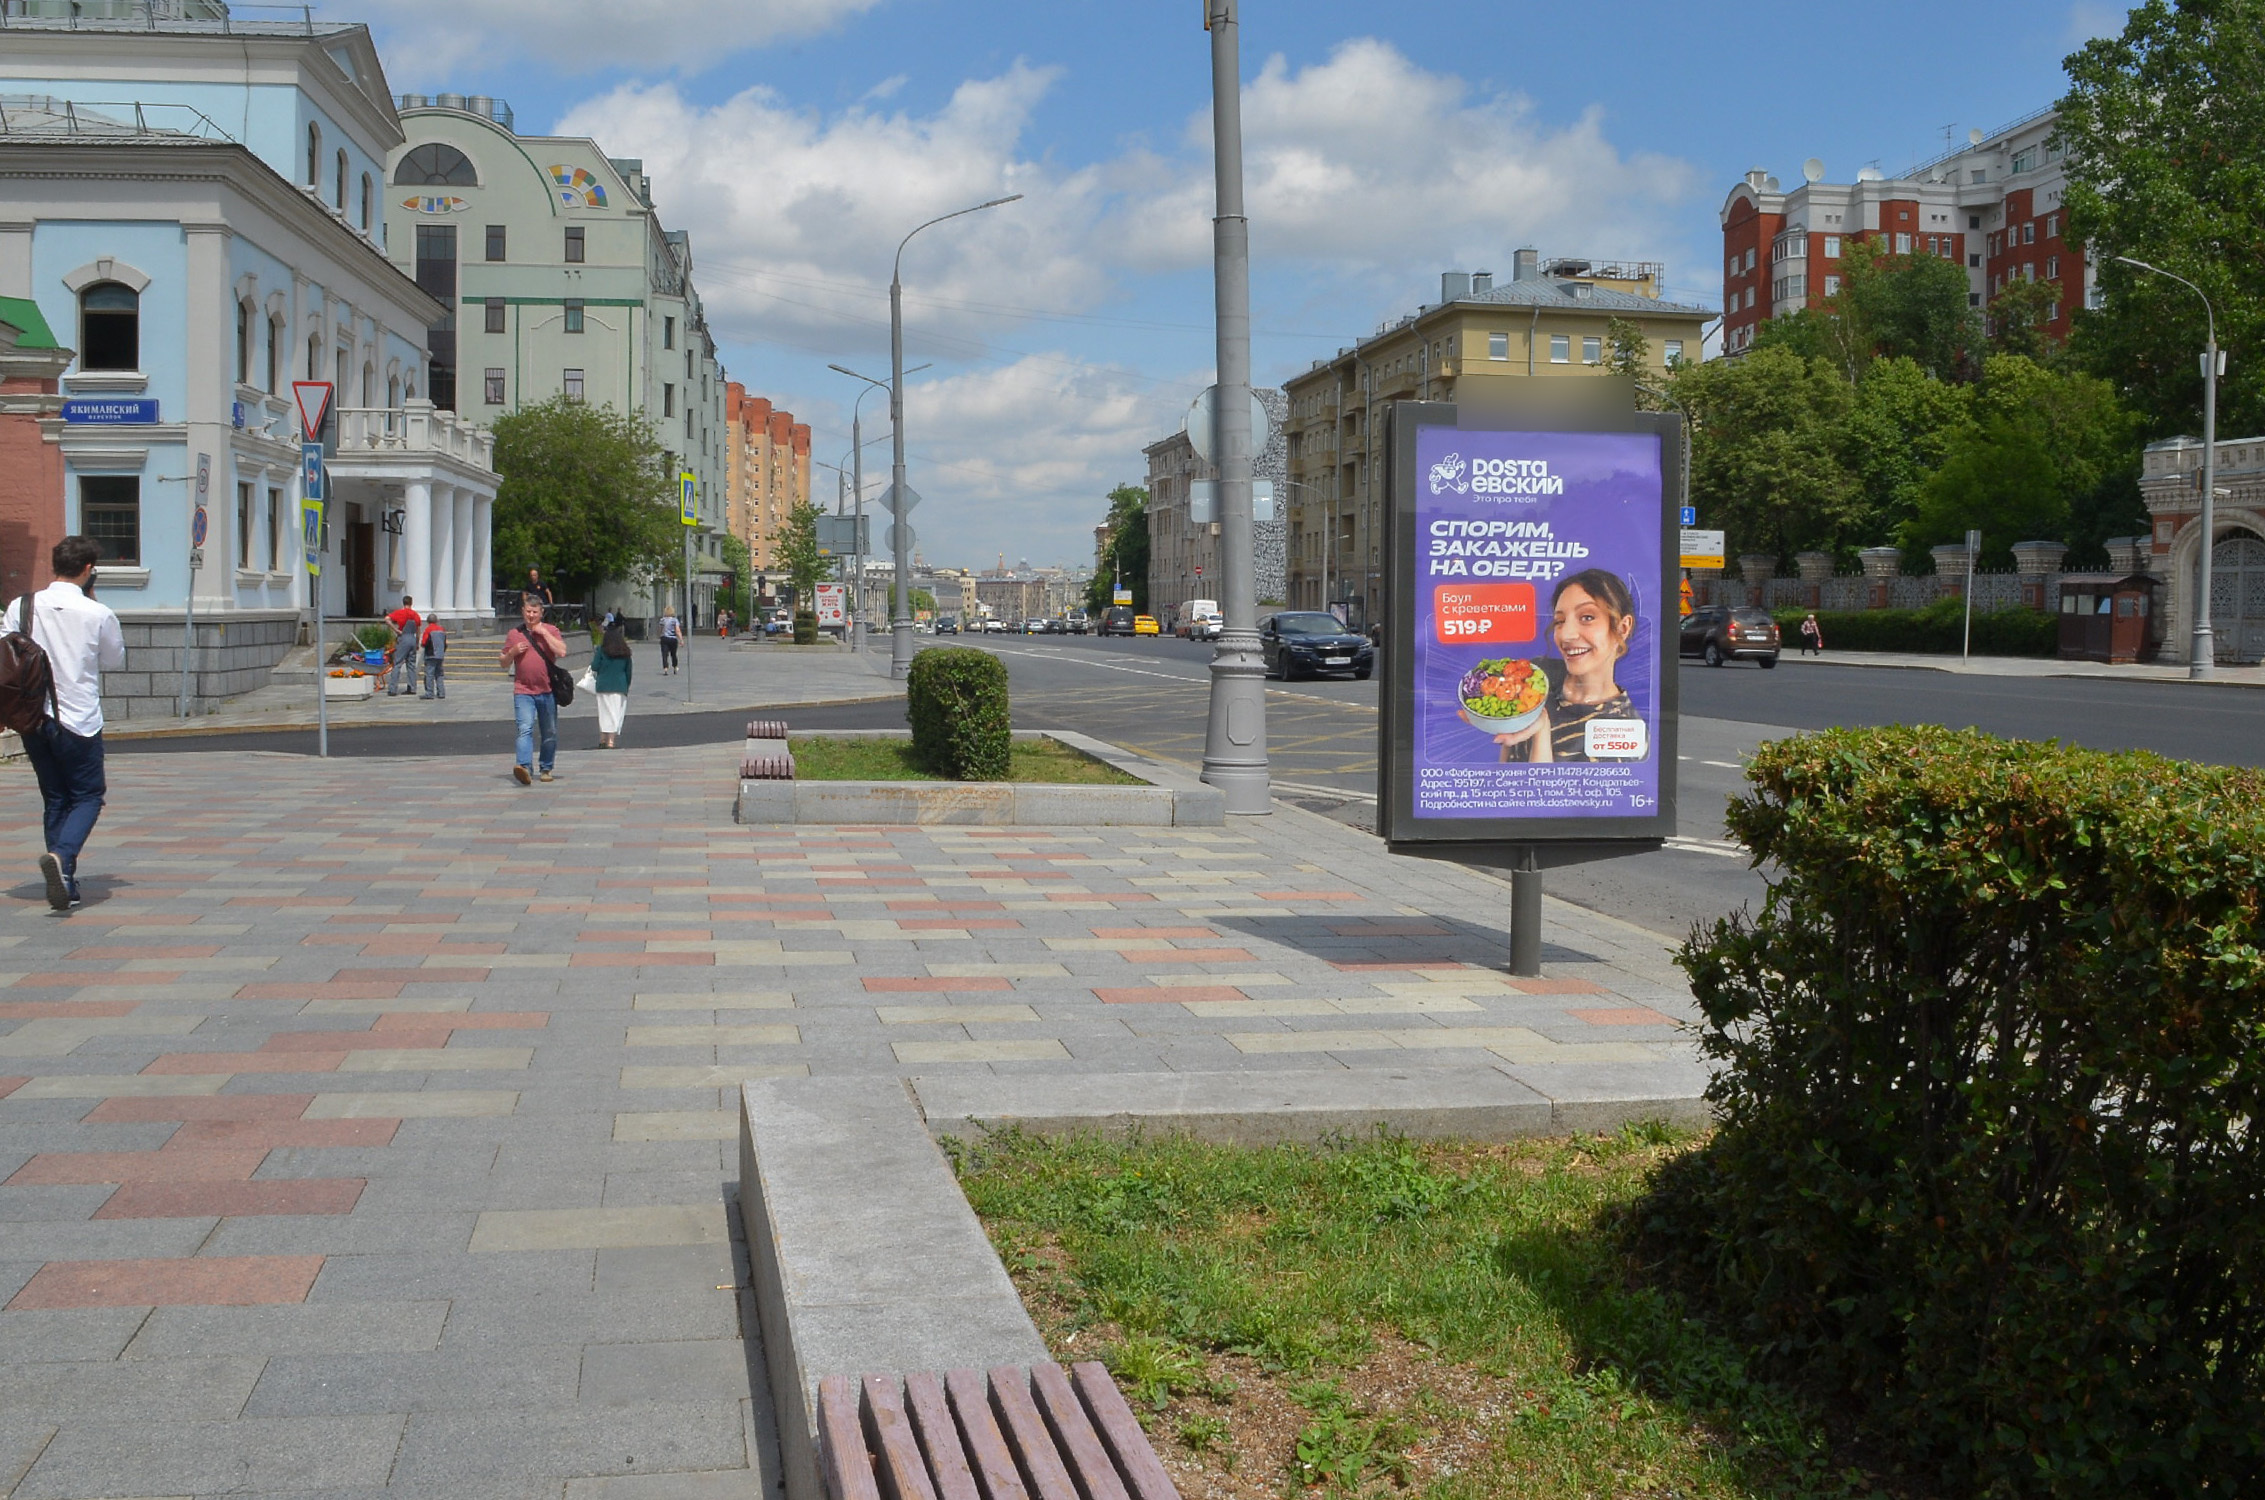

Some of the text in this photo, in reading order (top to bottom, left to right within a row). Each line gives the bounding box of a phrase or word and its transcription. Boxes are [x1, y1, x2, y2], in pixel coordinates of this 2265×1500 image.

[70, 403, 139, 414] ЯКИМАНСКИЙ
[1493, 496, 1512, 504] про
[1514, 496, 1537, 504] тебя
[1430, 520, 1555, 540] СПОРИМ,
[1429, 539, 1590, 558] ЗАКАЖЕШЬ
[1429, 559, 1565, 581] НА ОБЕД?
[1442, 592, 1472, 605] Боул
[1442, 604, 1526, 616] с креветками
[1443, 619, 1492, 635] 519₽
[1607, 741, 1638, 750] 550₽
[1420, 768, 1444, 777] ООО
[1444, 768, 1527, 779] «Фабрика-кухня»
[1527, 767, 1556, 777] ОГРН
[1420, 779, 1452, 790] Адрес:
[1582, 778, 1645, 787] Кондратьев-
[1420, 790, 1442, 798] ский
[1471, 788, 1481, 797] 15
[1509, 788, 1516, 797] 5
[1517, 789, 1535, 799] стр.
[1420, 798, 1613, 810] Подробности на сайте msk.dostaevsky.ru
[1629, 794, 1655, 807] 16+
